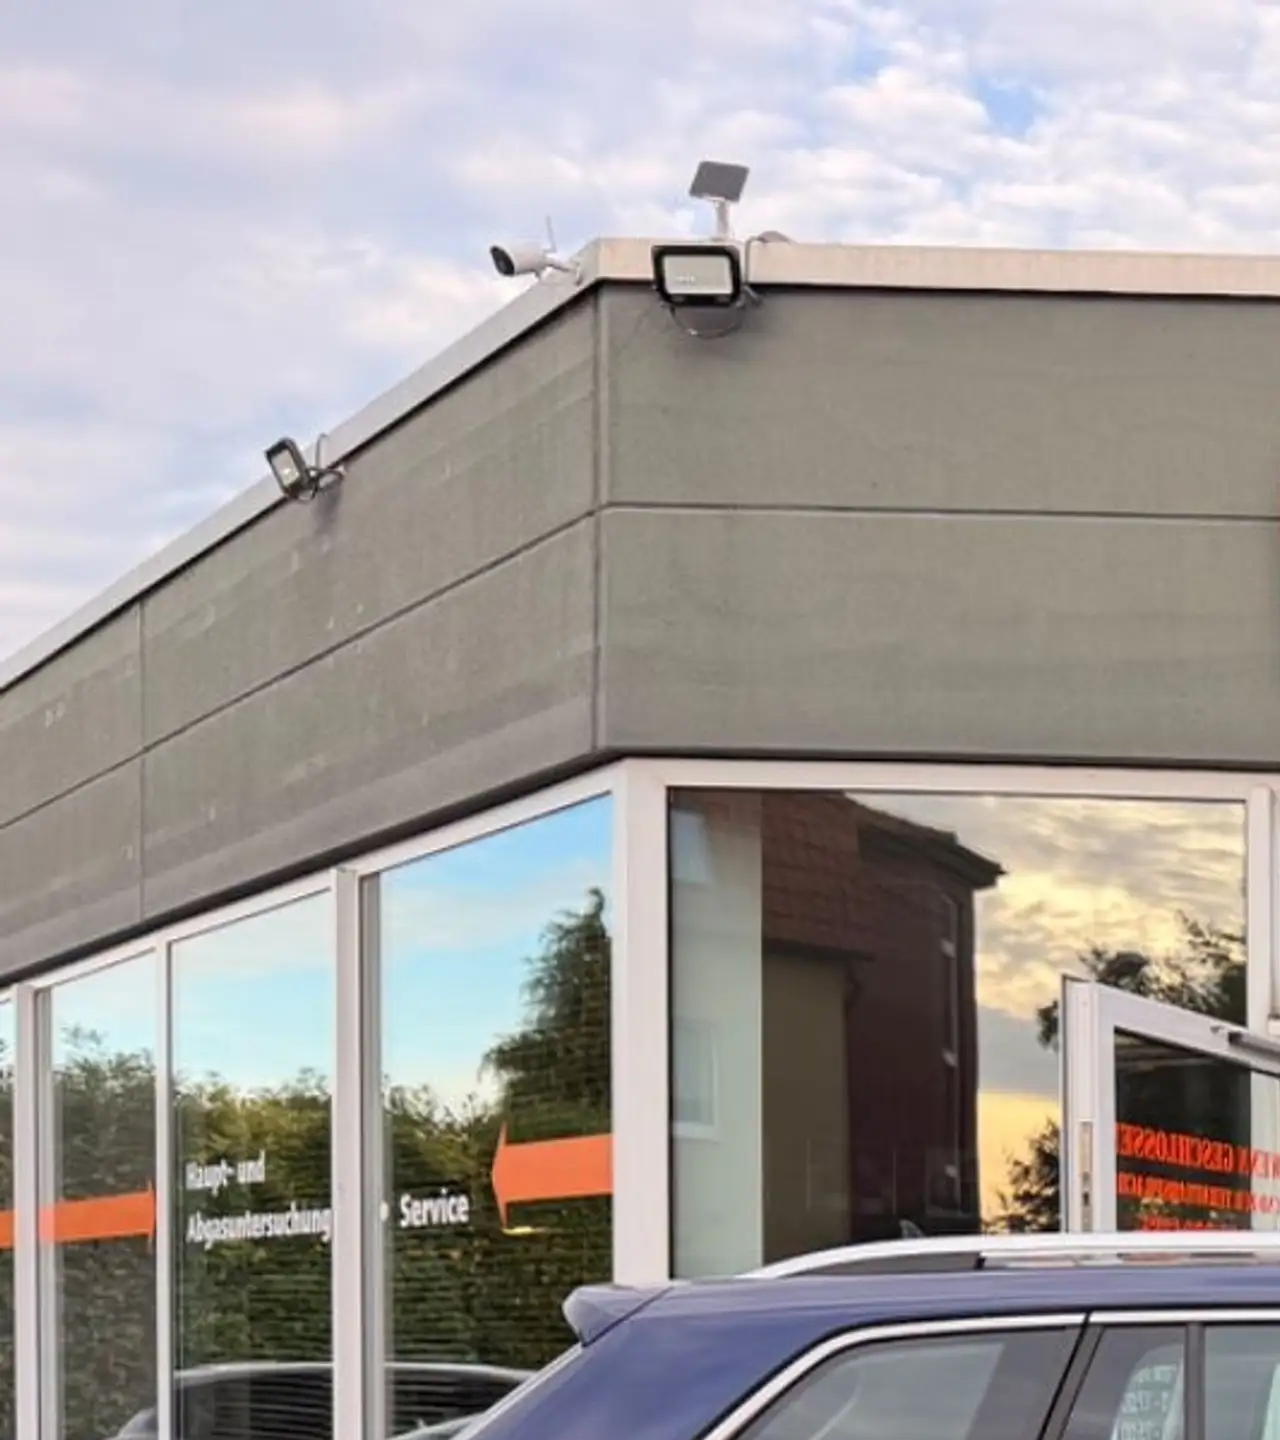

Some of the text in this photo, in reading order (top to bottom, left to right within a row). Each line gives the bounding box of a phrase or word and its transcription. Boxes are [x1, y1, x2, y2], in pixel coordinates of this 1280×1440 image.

[185, 1149, 267, 1198] Haupt- und
[399, 1188, 470, 1229] Service
